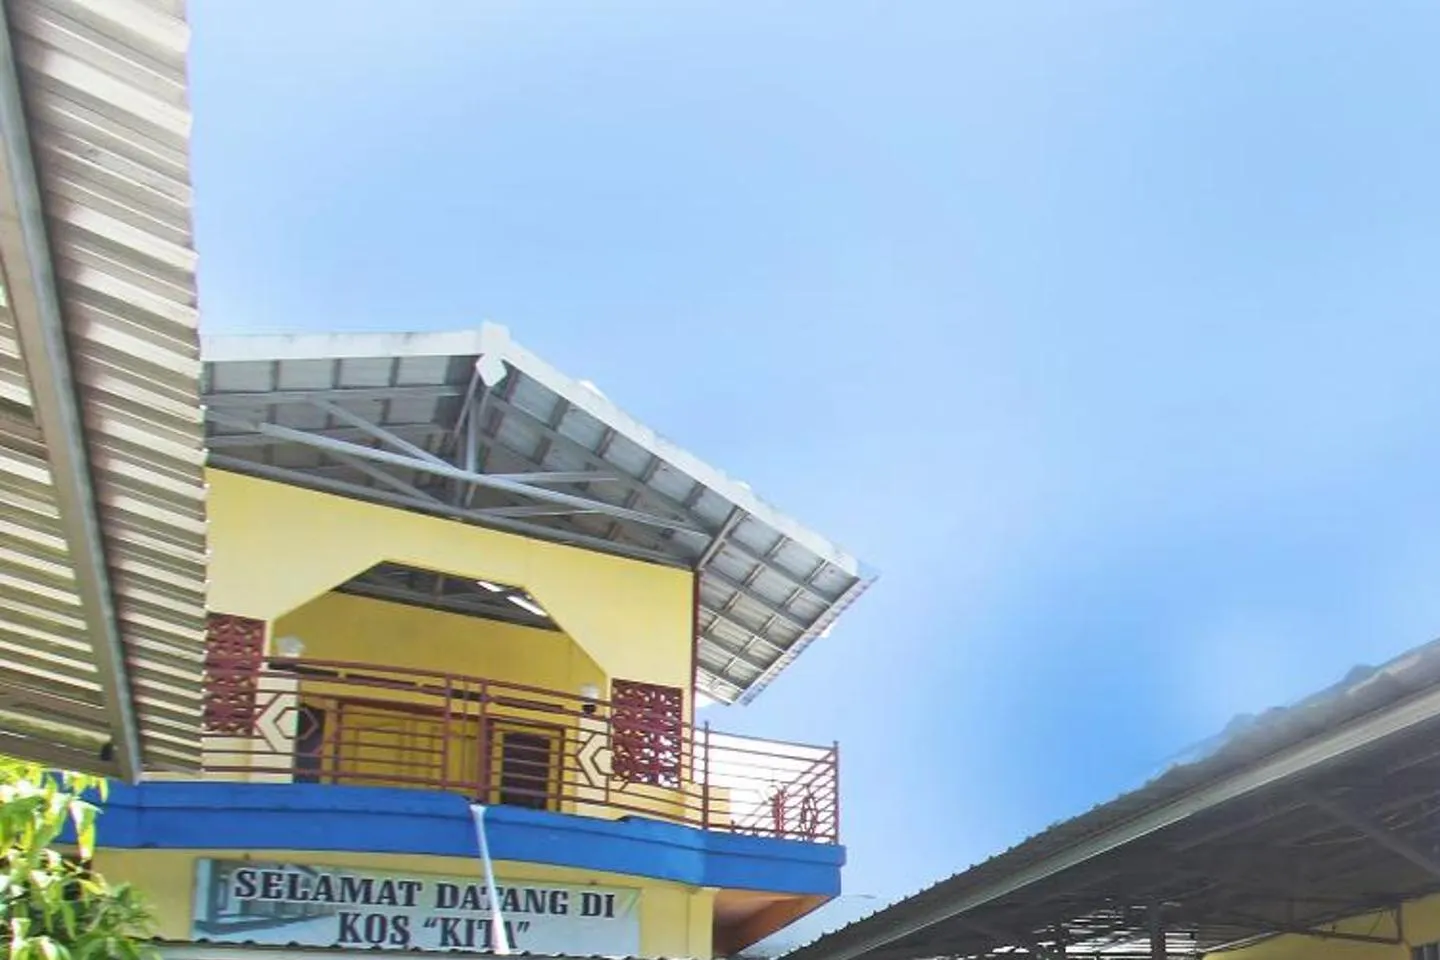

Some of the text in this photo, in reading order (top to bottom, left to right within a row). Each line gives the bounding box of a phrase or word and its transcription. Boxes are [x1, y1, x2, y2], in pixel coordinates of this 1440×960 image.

[234, 869, 423, 907] SELAMAT
[580, 891, 616, 918] DI
[337, 911, 411, 945] KOS
